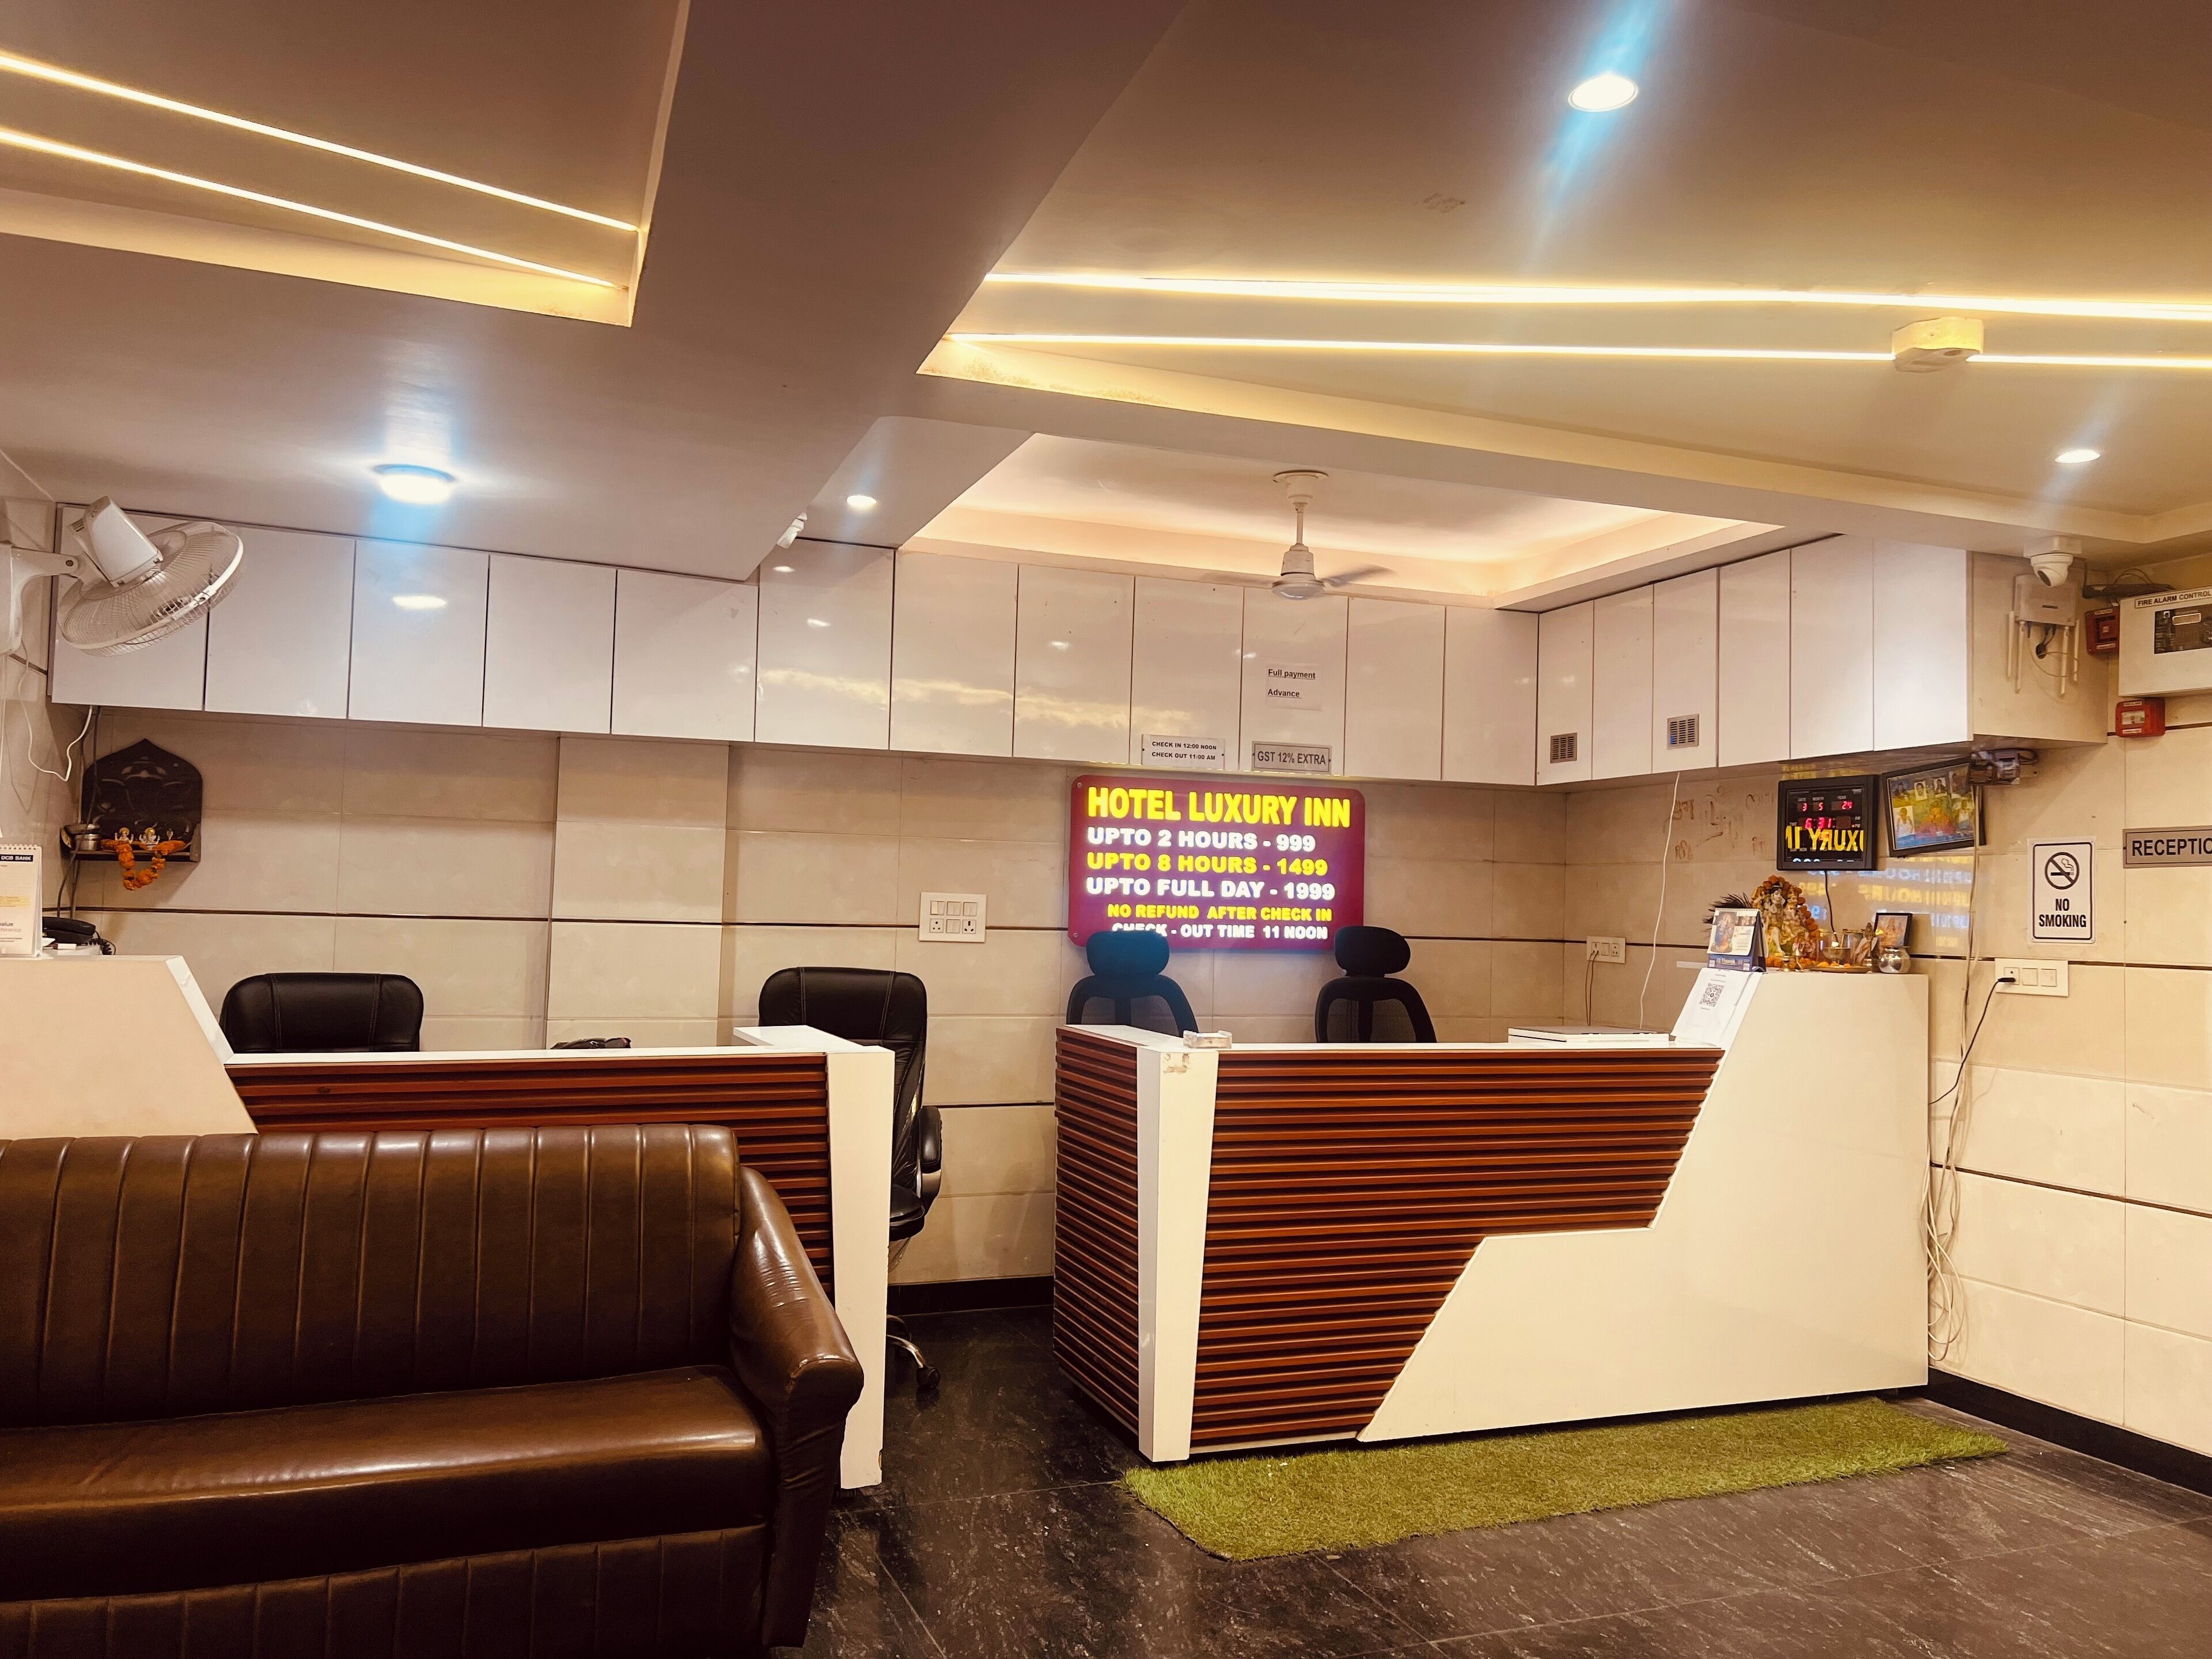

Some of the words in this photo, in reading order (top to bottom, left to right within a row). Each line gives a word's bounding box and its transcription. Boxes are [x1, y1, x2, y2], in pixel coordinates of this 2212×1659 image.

[2153, 595, 2177, 604] ALARM
[2179, 590, 2211, 600] CONTROL
[1284, 671, 1315, 679] payment
[1268, 688, 1300, 697] Advance
[1257, 751, 1275, 762] GST
[1278, 752, 1295, 763] 12%
[1297, 753, 1326, 765] EXTRA
[1087, 786, 1181, 821] HOTEL
[1188, 791, 1297, 825] LUXURY
[1304, 797, 1350, 828] INN
[1802, 802, 1808, 812] 3
[1818, 802, 1824, 810] 5
[1087, 827, 1152, 847] UPTO
[1157, 830, 1172, 847] 2
[1178, 830, 1258, 850] HOURS
[1276, 834, 1316, 853] 999
[1086, 852, 1152, 871] UPTO
[1157, 853, 1172, 872] 8
[1178, 855, 1257, 875] HOURS
[1277, 858, 1328, 876] 1499
[1086, 876, 1151, 896] UPTO
[1157, 878, 1215, 898] FULL
[1221, 880, 1266, 899] DAY
[1283, 882, 1336, 901] 1999
[2055, 898, 2070, 911] NO
[1108, 903, 1132, 918] NO
[1135, 904, 1199, 919] REFUND
[1207, 906, 1257, 921] AFTER
[1260, 907, 1313, 922] CHECK
[1316, 908, 1332, 922] IN
[2039, 914, 2086, 927] SMOKING
[1180, 924, 1214, 938] OUT
[1217, 925, 1255, 939] TIME
[1262, 925, 1280, 939] 11
[1283, 926, 1328, 940] NOON
